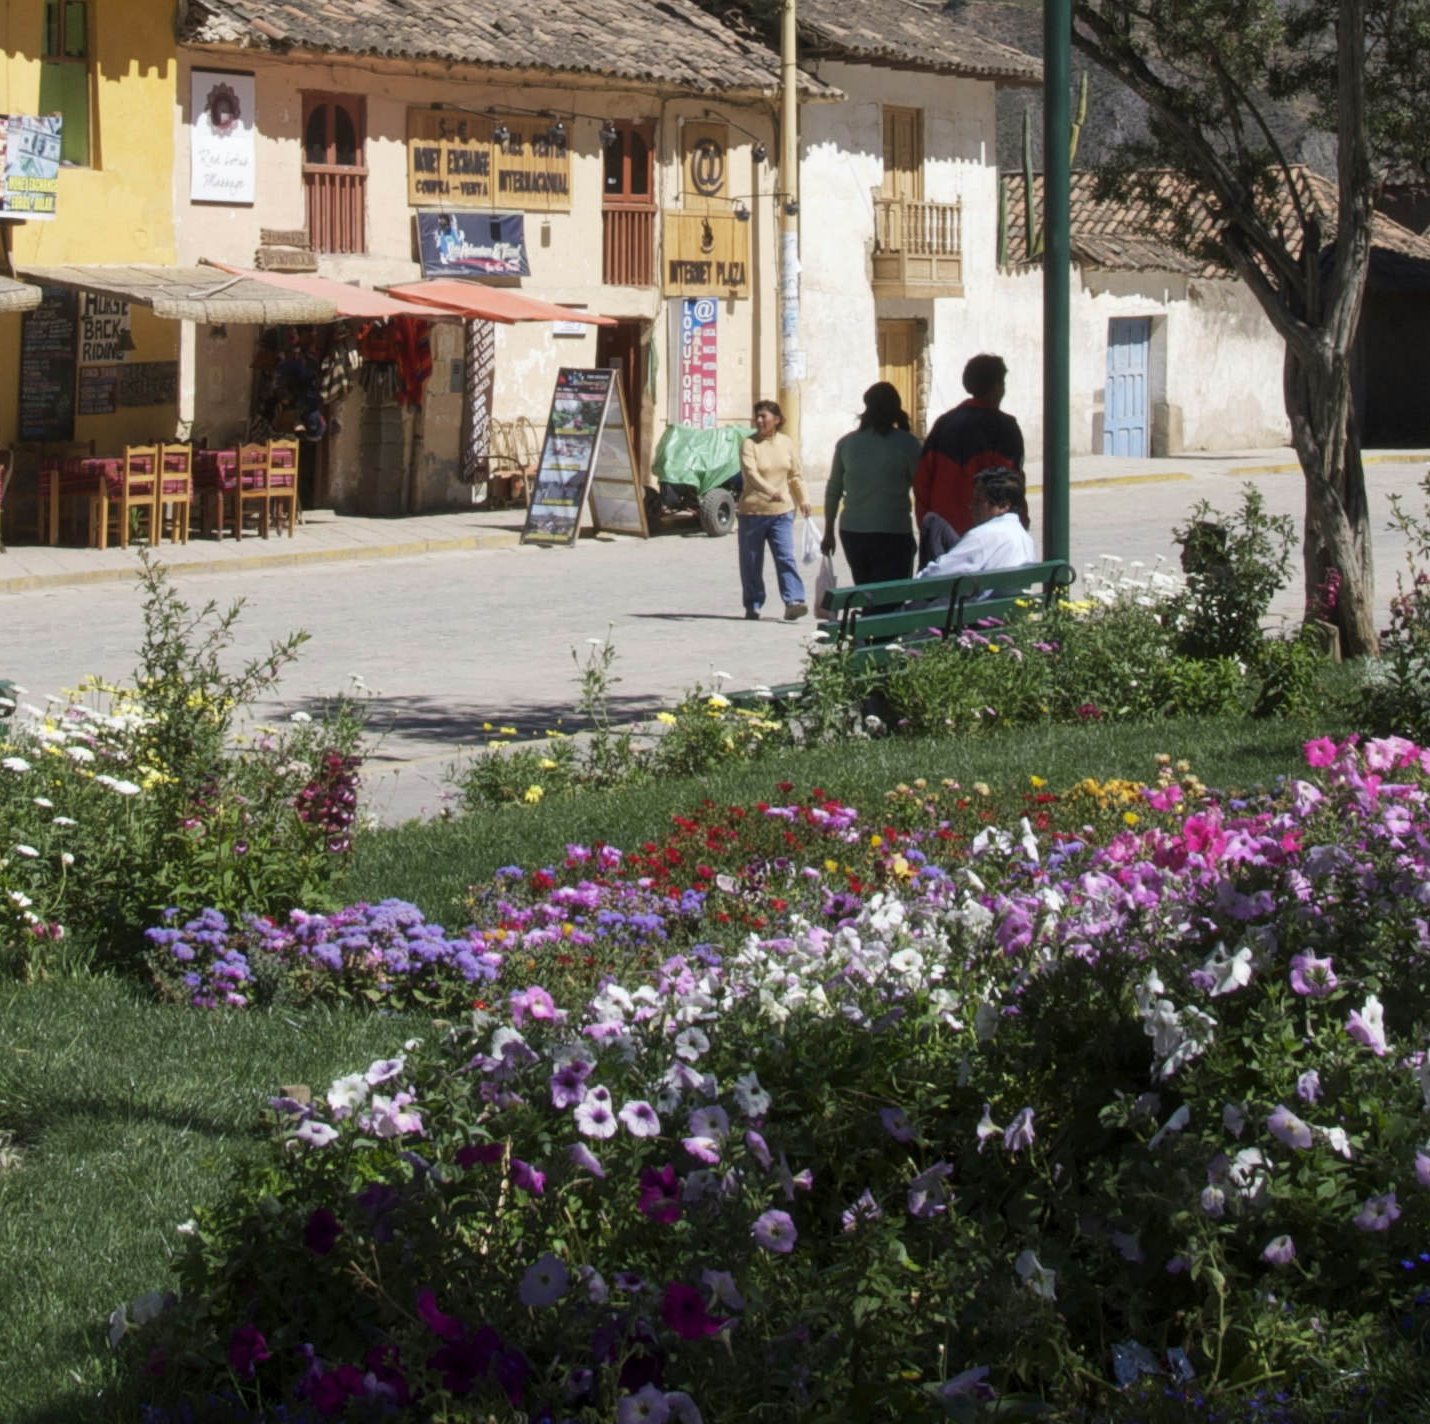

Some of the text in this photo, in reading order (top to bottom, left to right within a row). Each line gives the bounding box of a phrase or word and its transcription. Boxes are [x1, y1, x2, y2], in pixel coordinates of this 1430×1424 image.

[198, 149, 221, 167] Red
[414, 147, 490, 176] MONEY EXCHANGE
[690, 138, 724, 196] @
[202, 174, 245, 196] Massage
[460, 181, 489, 196] VENTA
[499, 169, 569, 195] INTERNACIONAL
[669, 260, 746, 286] INTERNET PLAZA
[694, 300, 714, 323] @
[84, 319, 121, 340] BACK
